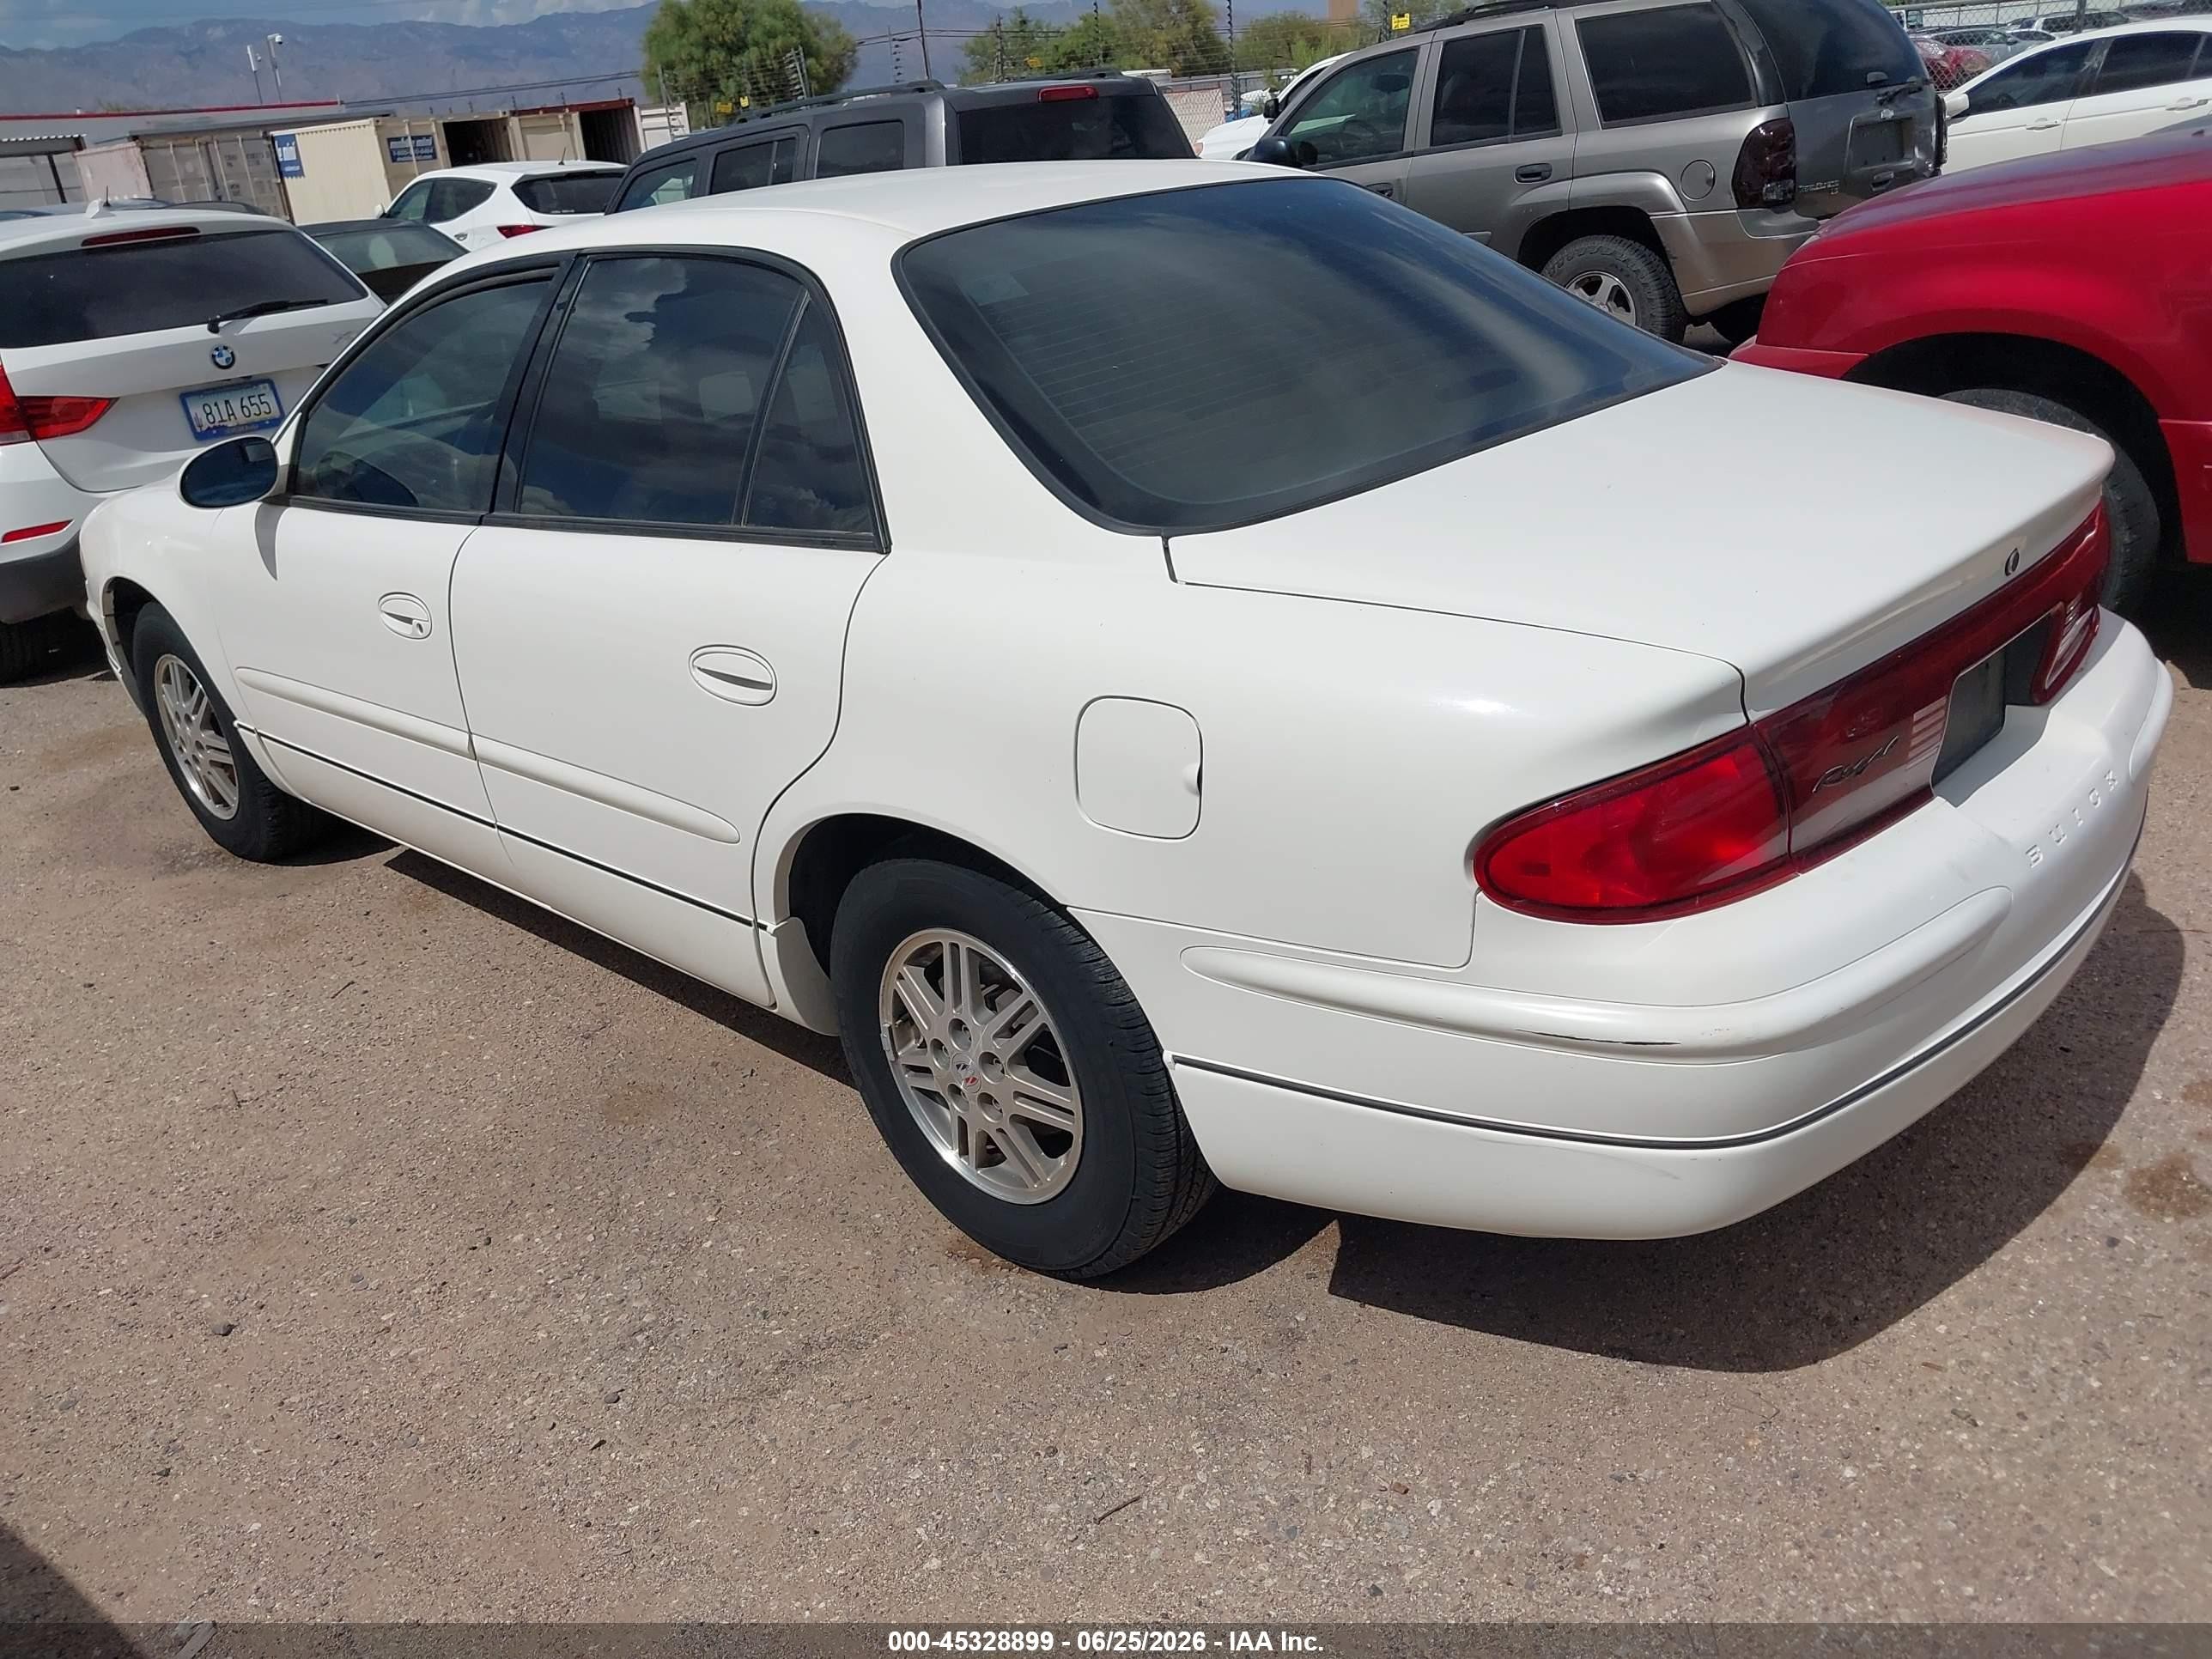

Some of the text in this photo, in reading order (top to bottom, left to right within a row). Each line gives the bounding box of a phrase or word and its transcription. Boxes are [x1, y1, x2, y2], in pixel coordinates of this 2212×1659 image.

[202, 393, 272, 425] 81A 655
[2025, 769, 2118, 869] BUICK
